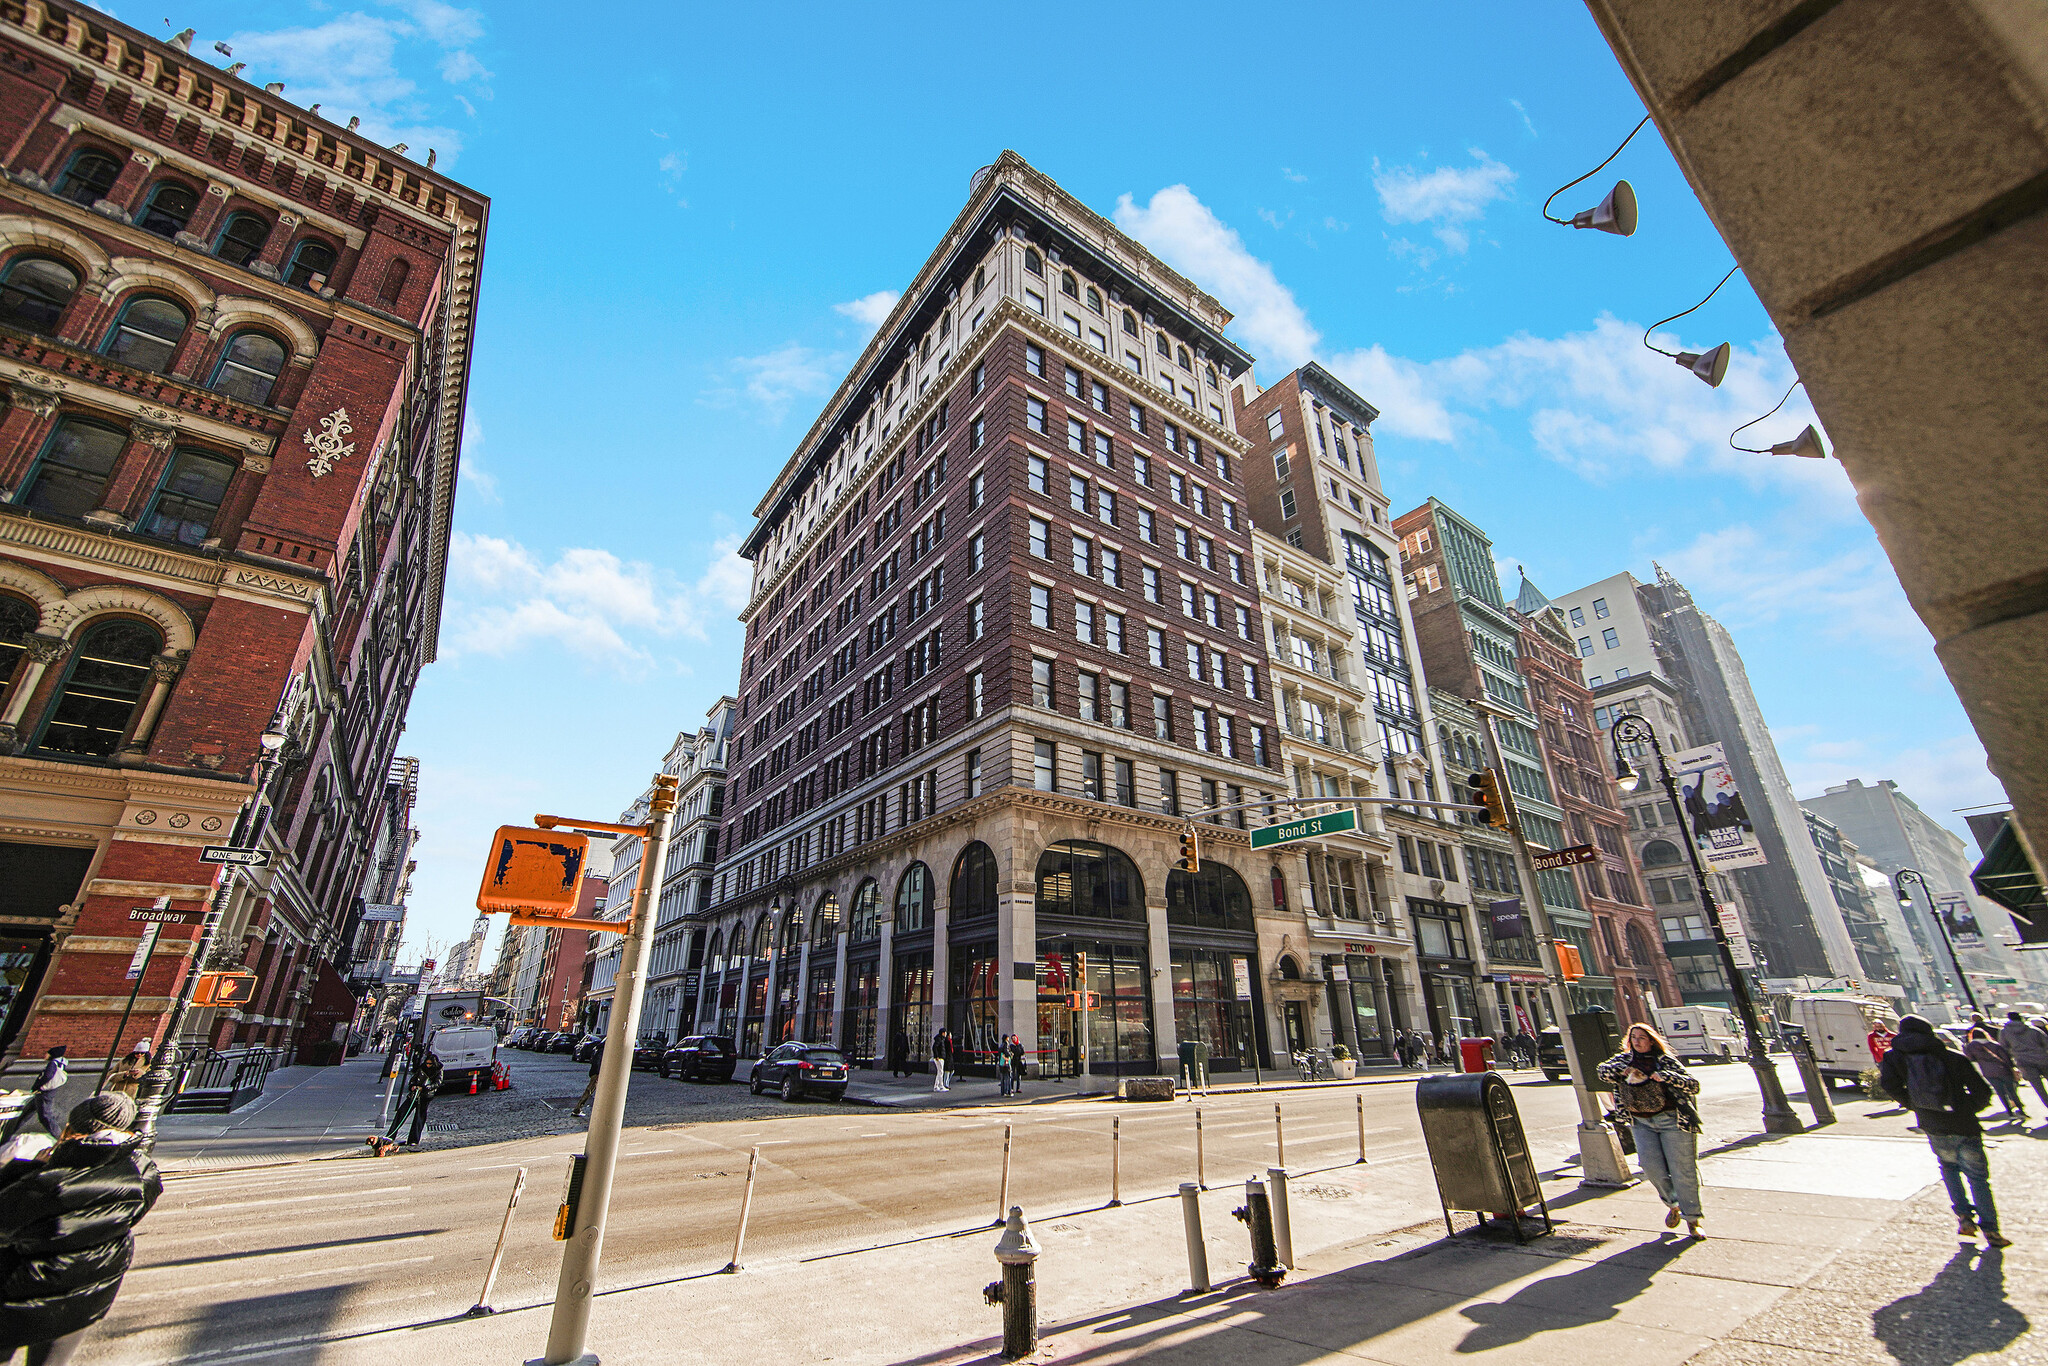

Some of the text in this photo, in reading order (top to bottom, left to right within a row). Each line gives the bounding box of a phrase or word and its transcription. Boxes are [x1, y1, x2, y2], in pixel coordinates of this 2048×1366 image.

[1681, 758, 1699, 766] NoHo
[1278, 820, 1323, 839] Bond St
[1708, 826, 1737, 836] BLUE
[1711, 833, 1740, 844] MAN
[1714, 839, 1742, 849] GROUP
[211, 851, 262, 862] ONE WAY
[1534, 852, 1579, 869] Bond St
[1708, 854, 1737, 863] SINCE
[129, 910, 187, 924] Broadway
[1496, 912, 1519, 922] spear
[1350, 943, 1376, 954] CITYMD
[443, 1006, 464, 1016] Baldor
[1792, 1034, 1799, 1045] P
